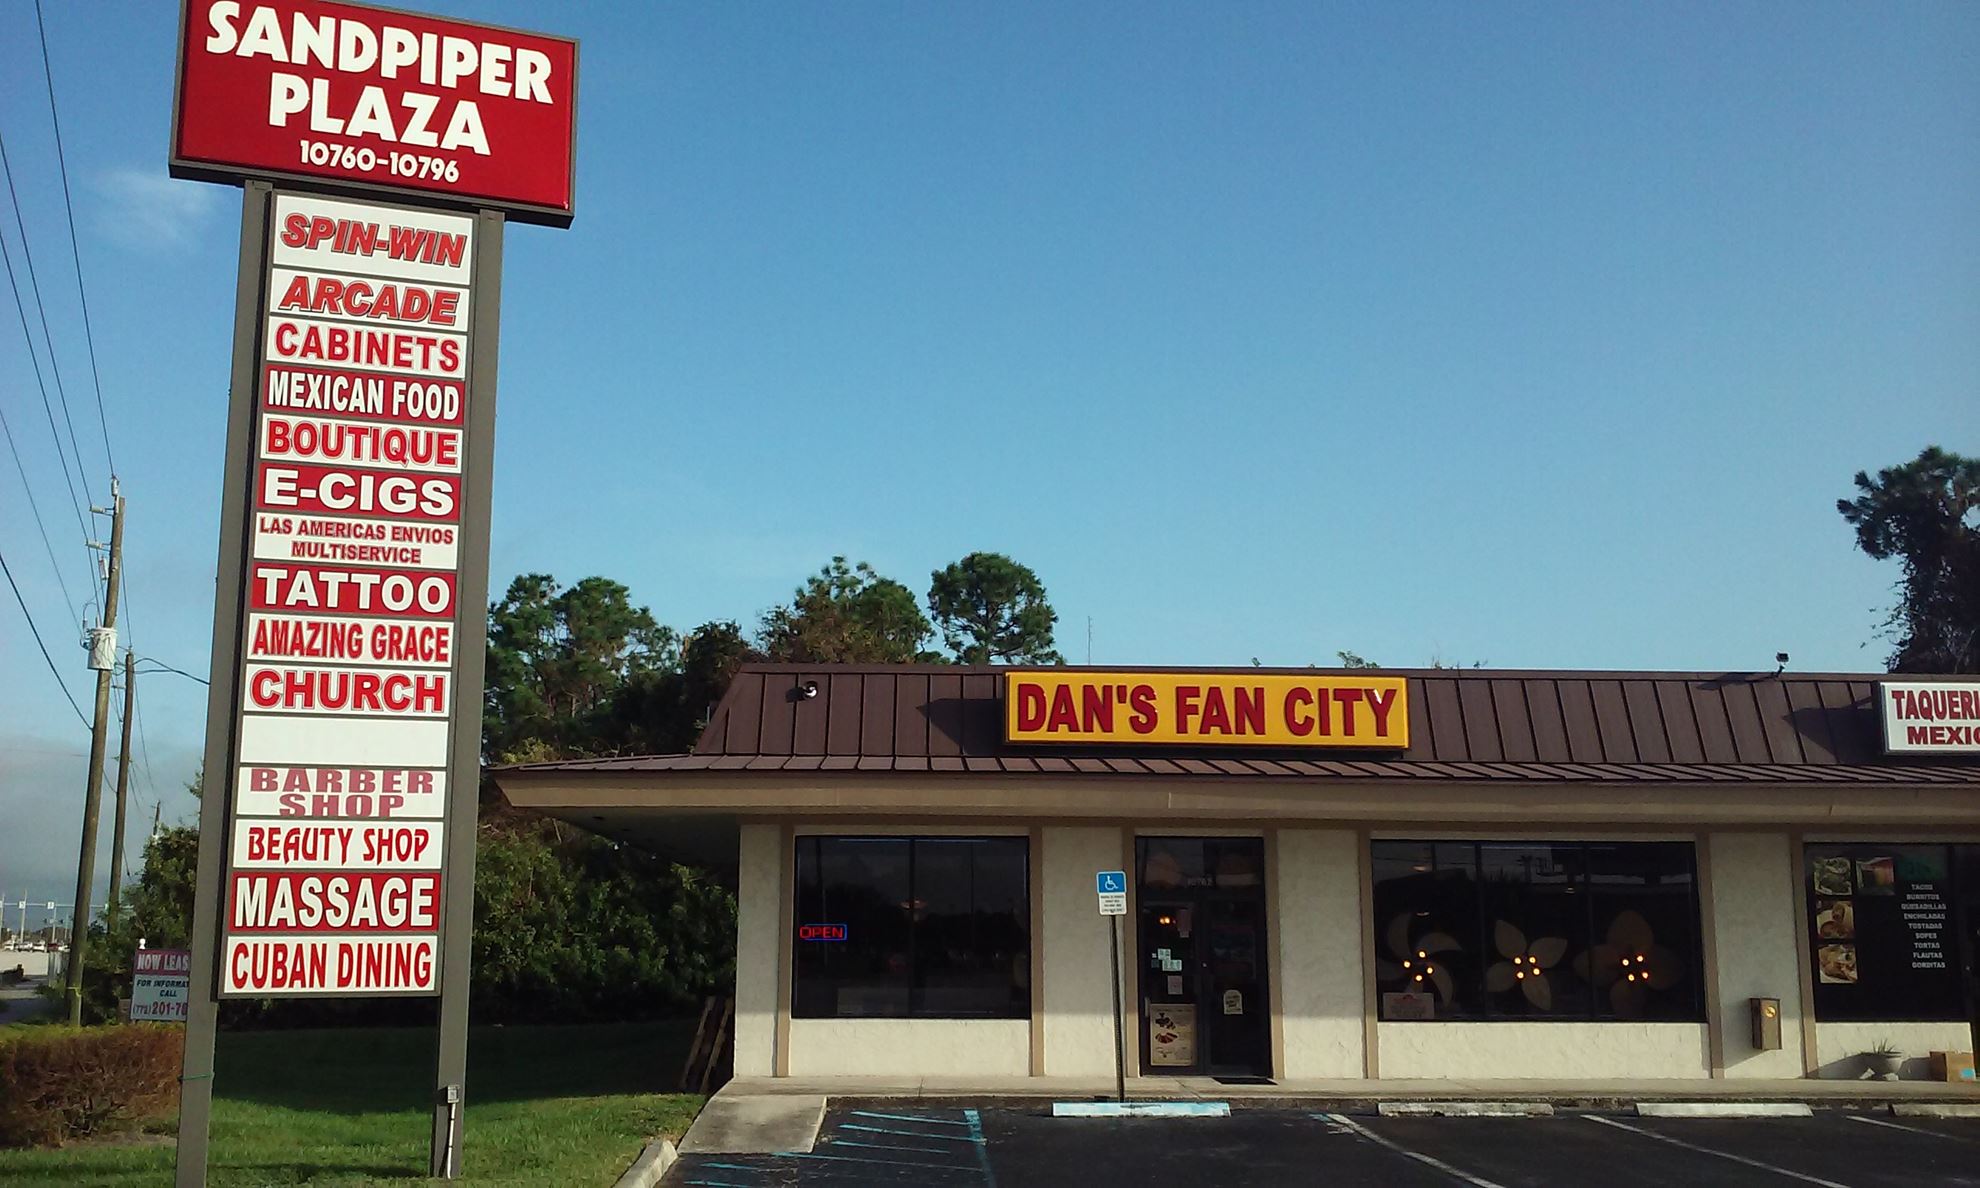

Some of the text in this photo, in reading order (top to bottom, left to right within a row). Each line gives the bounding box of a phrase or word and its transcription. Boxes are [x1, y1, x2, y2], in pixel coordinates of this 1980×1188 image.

[206, 0, 553, 104] SANDPIPER
[269, 72, 491, 155] PLAZA
[300, 140, 460, 183] 10760-10796
[280, 213, 468, 267] SPIN-WIN
[278, 275, 460, 327] ARCADE
[275, 322, 460, 373] CABINETS
[268, 370, 460, 421] MEXICAN FOOD
[266, 419, 458, 467] BOUTIQUE
[264, 468, 454, 516] E-CIGS
[260, 517, 454, 545] LAS AMERICAS ENVIOS
[291, 541, 421, 564] MULTISERVICE
[257, 568, 450, 613] TATTOO
[252, 619, 449, 663] AMAZING GRACE
[250, 669, 446, 713] CHURCH
[1017, 683, 1397, 737] DAN'S FAN CITY
[250, 768, 433, 794] BARBER
[278, 793, 404, 817] SHOP
[248, 827, 429, 866] BEAUTY SHOP
[235, 877, 434, 928] MASSAGE
[800, 926, 843, 938] OPEN
[137, 953, 188, 971] NOW LEAS
[137, 979, 151, 987] FOR
[231, 942, 431, 989] CUBAN DINING
